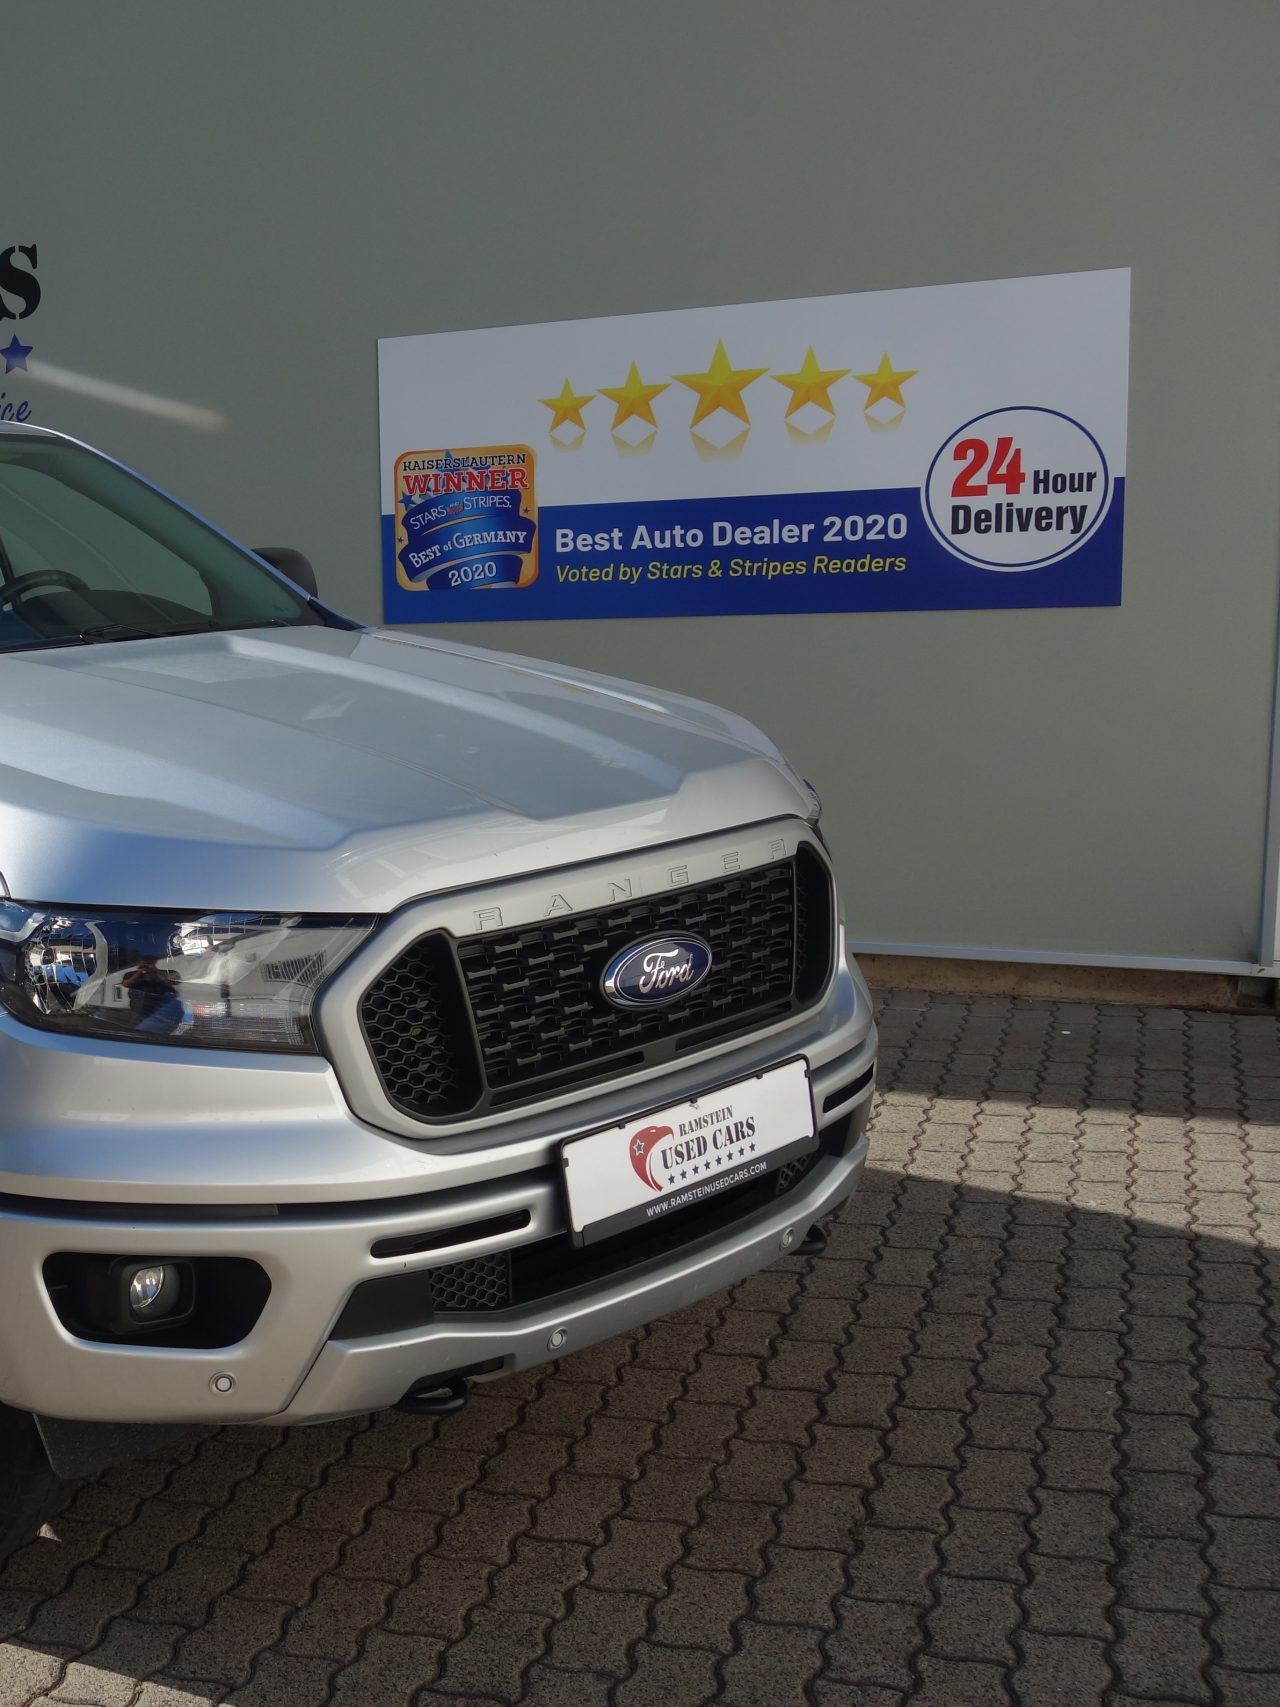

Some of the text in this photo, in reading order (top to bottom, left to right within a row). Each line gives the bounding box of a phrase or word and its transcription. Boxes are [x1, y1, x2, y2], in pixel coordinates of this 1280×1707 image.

[403, 454, 526, 471] KAISERSLAUTERN
[951, 436, 1097, 498] 24 Hour
[402, 467, 529, 495] WINNER
[410, 505, 447, 530] STARS
[555, 513, 908, 553] Best Auto Dealer 2020
[950, 502, 1088, 535] Delivery
[408, 530, 527, 568] BEST of GERMANY
[448, 561, 497, 587] 2020
[556, 554, 907, 585] Voted by Stars & Stripes Readers
[472, 838, 787, 931] RANGER
[639, 948, 694, 993] Ford
[678, 1105, 734, 1138] RAMSTEIN
[660, 1116, 756, 1170] USED CARS
[645, 1161, 767, 1217] WWW.RAMSTEINUSEDCARS.COM
